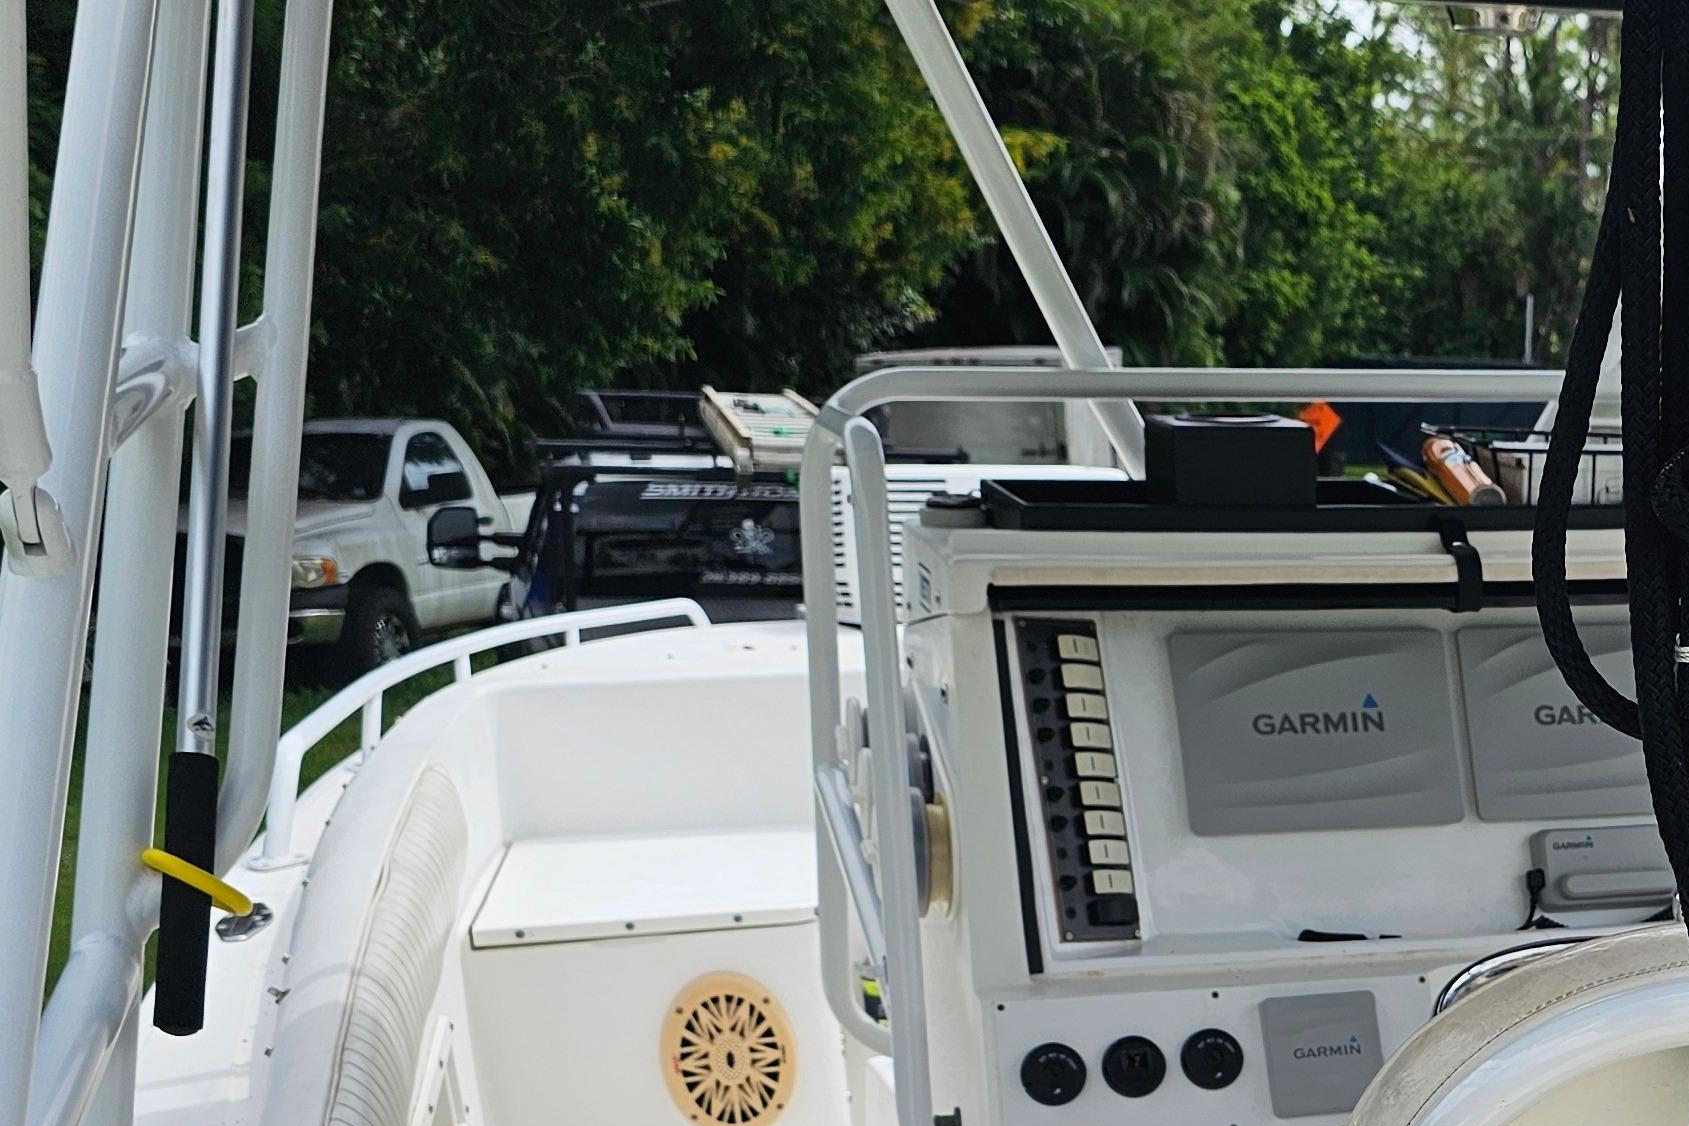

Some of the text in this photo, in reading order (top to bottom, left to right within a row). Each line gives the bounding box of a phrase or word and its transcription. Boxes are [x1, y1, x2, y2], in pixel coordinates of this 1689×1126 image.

[1252, 710, 1385, 736] GARMIN
[1534, 704, 1600, 726] GAR
[1552, 841, 1594, 850] GARMIN
[1293, 1043, 1362, 1059] GARMIN
